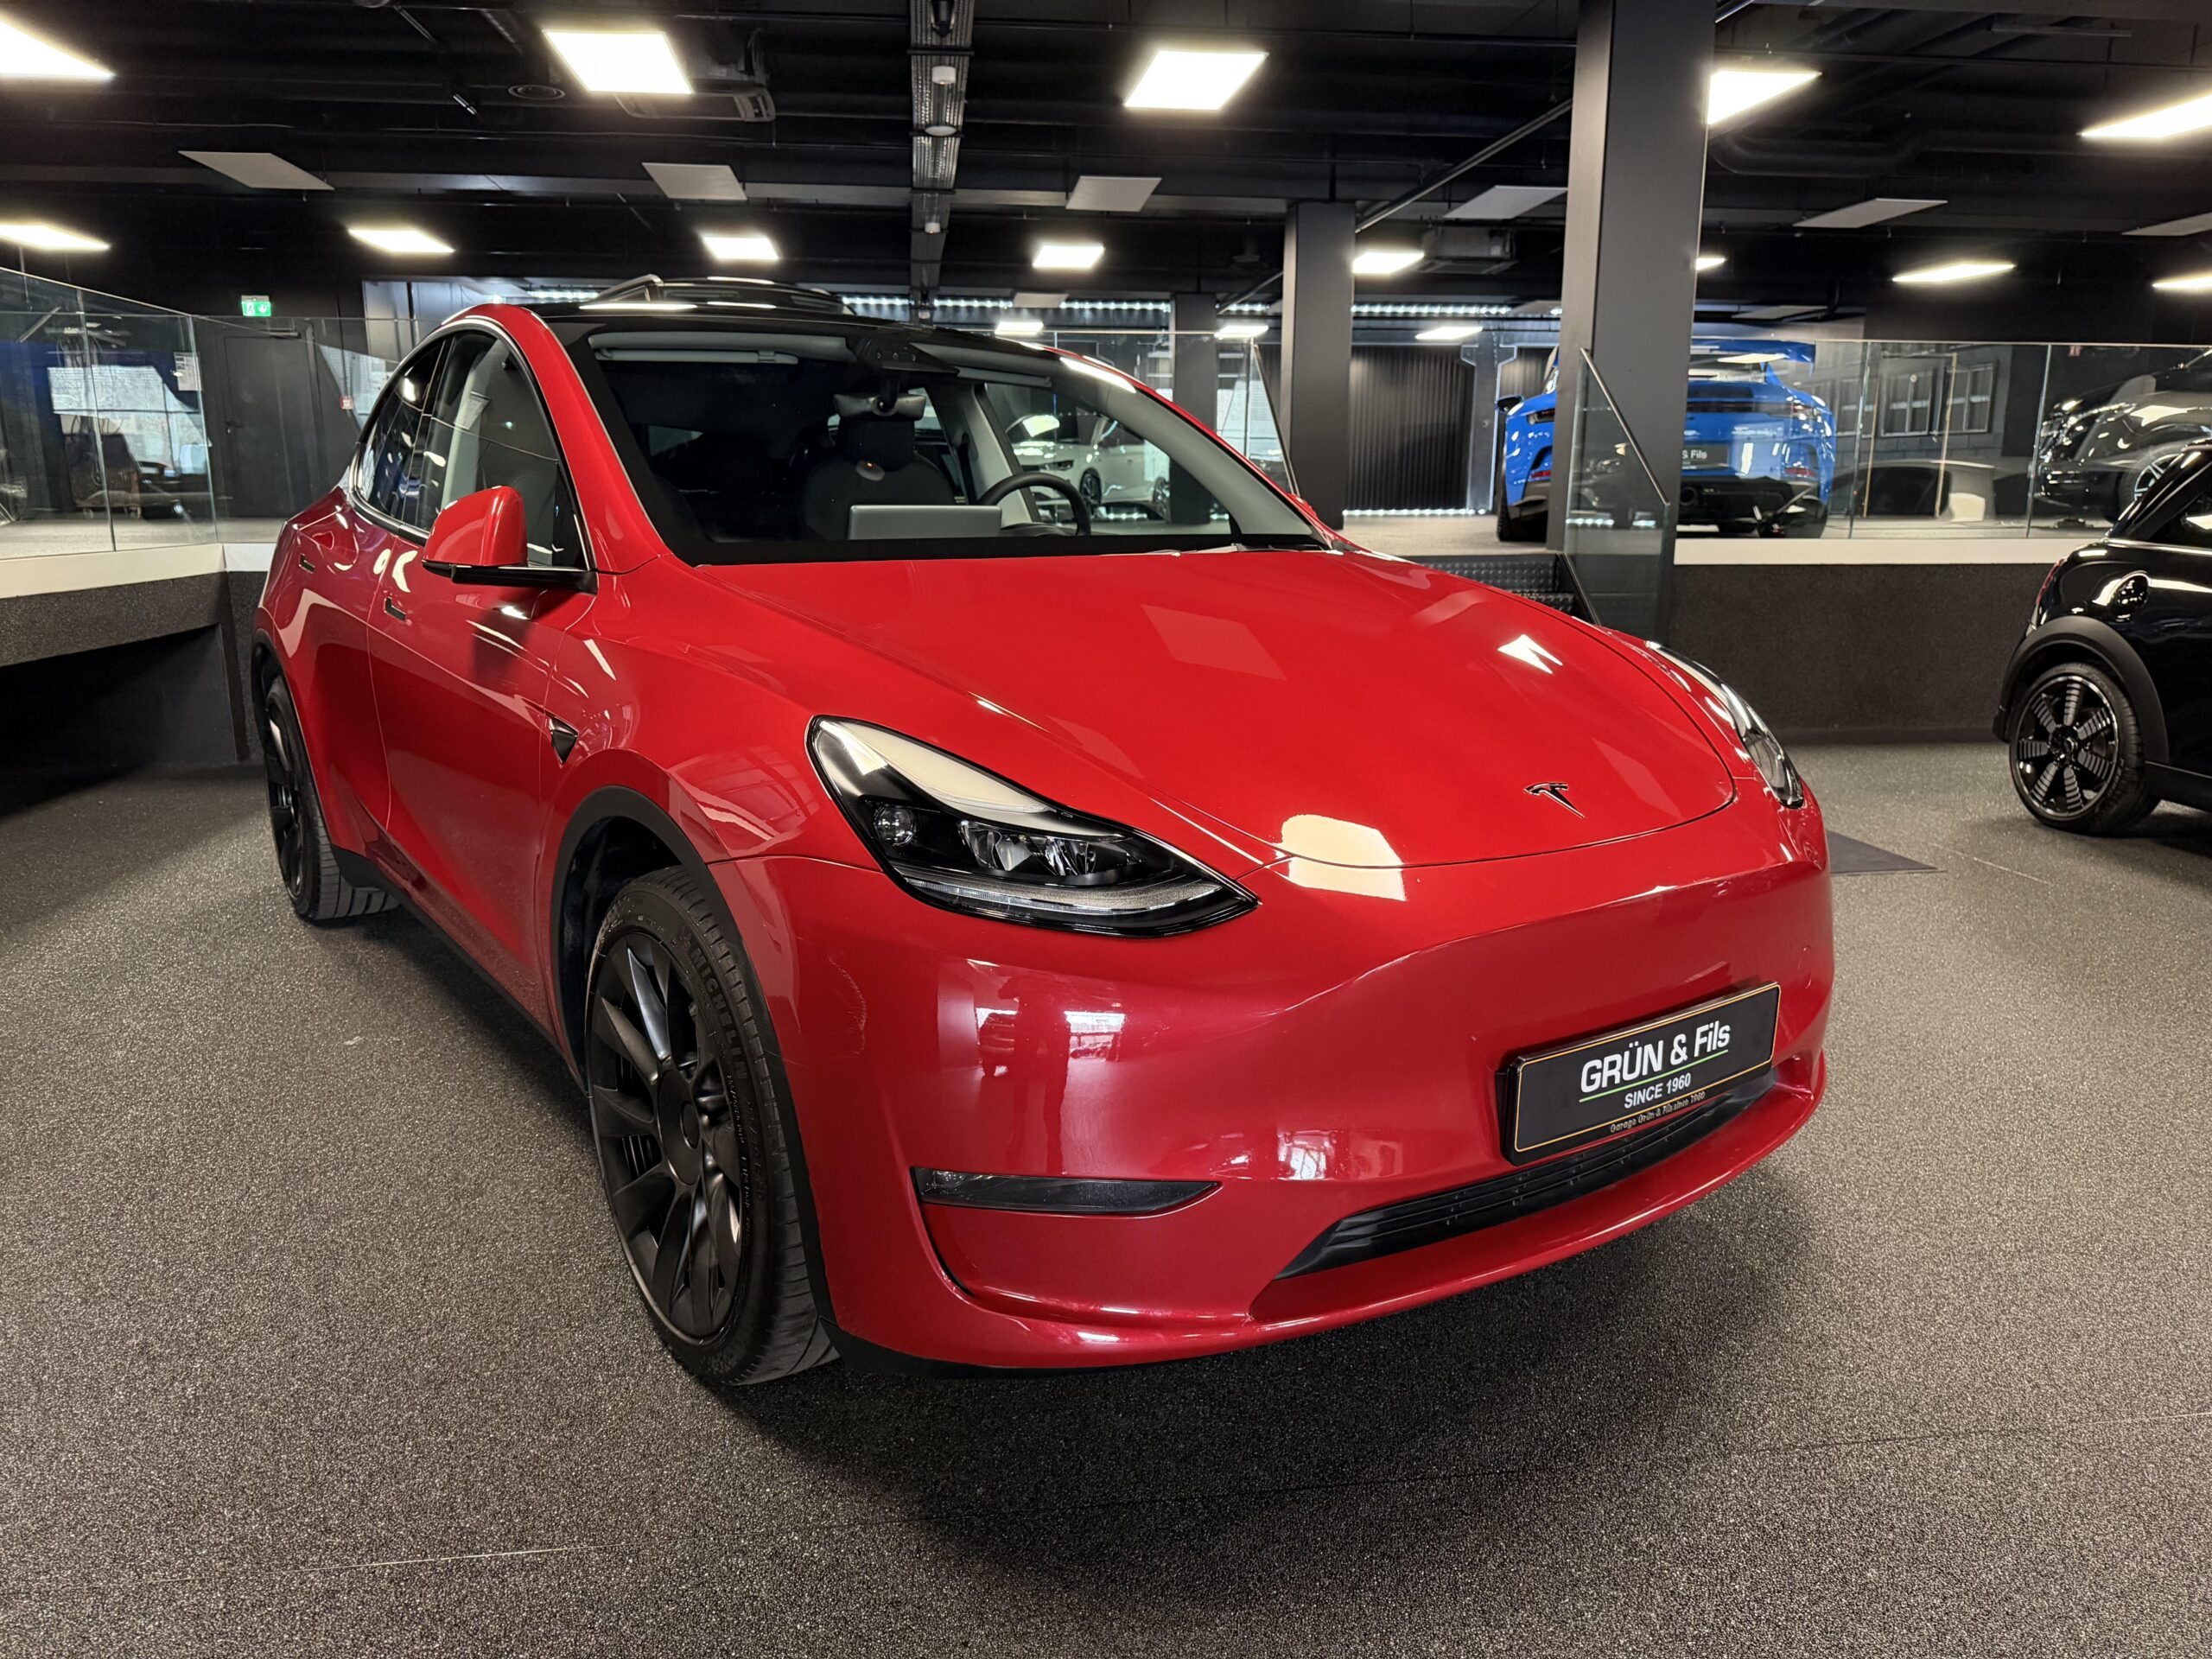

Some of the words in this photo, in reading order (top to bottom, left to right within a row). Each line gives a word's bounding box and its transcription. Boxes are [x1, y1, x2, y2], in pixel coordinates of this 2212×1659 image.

[690, 948, 747, 1079] MICHELIN
[1580, 1040, 1664, 1094] GRÜN
[1670, 1033, 1688, 1066] &
[1694, 1020, 1731, 1058] Fils
[1610, 1119, 1637, 1134] Garage
[1691, 1090, 1706, 1104] 1960
[1624, 1083, 1664, 1109] SINCE
[1666, 1072, 1692, 1095] 1960
